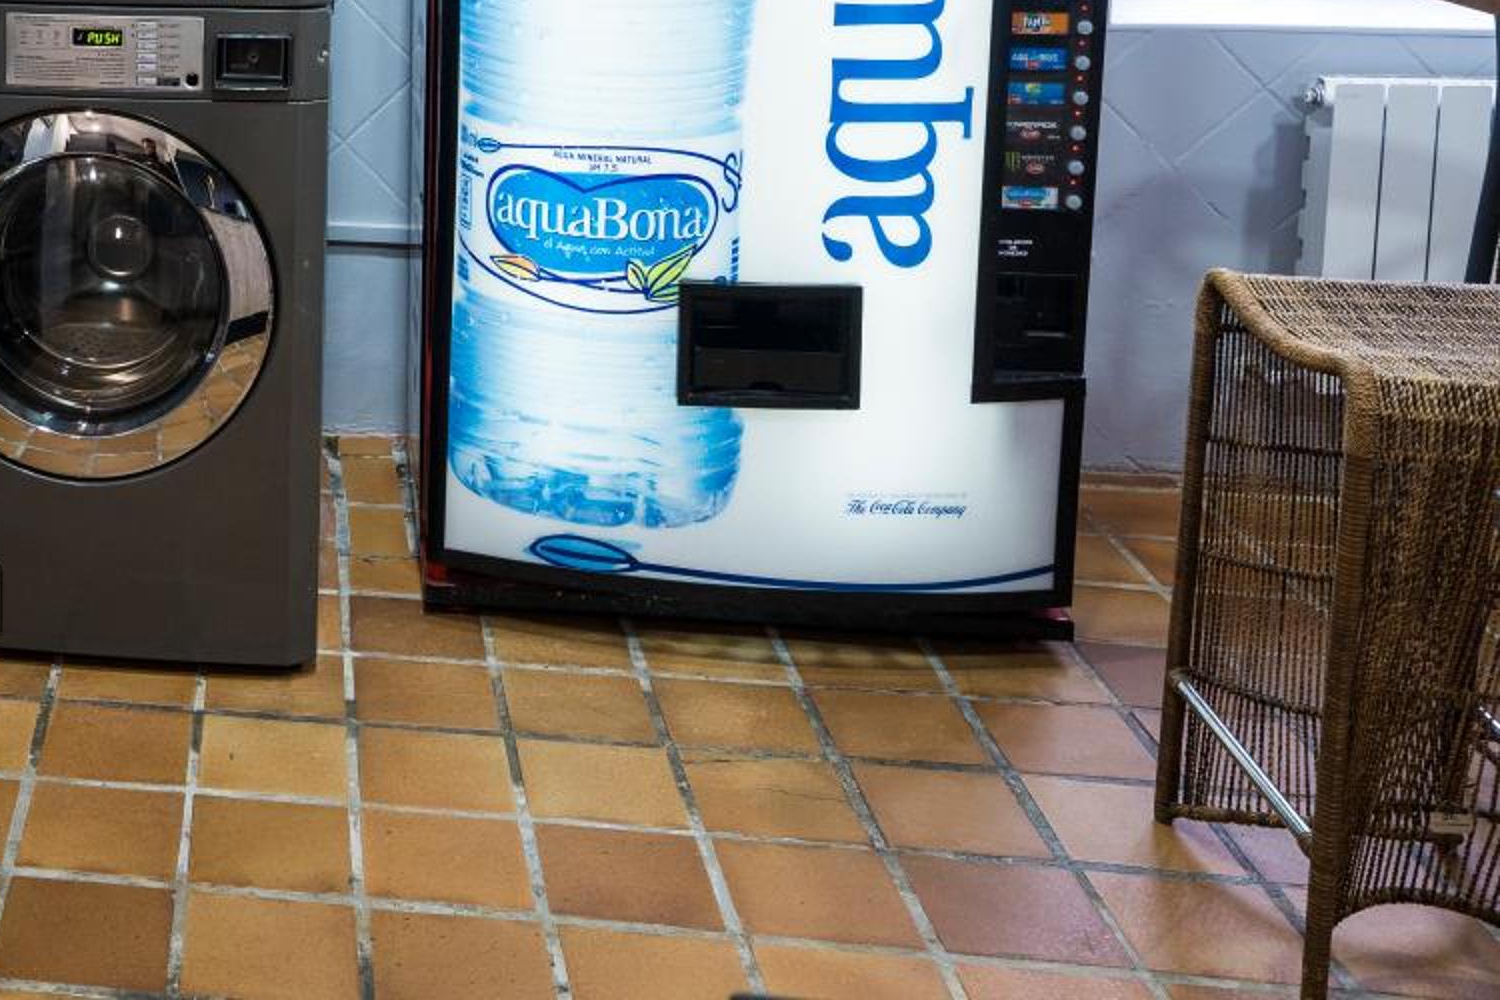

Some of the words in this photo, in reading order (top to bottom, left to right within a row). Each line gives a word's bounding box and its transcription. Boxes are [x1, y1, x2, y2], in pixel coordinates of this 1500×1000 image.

[86, 31, 120, 45] PUSH
[615, 155, 652, 164] NATURAL
[497, 192, 703, 241] aquaBona
